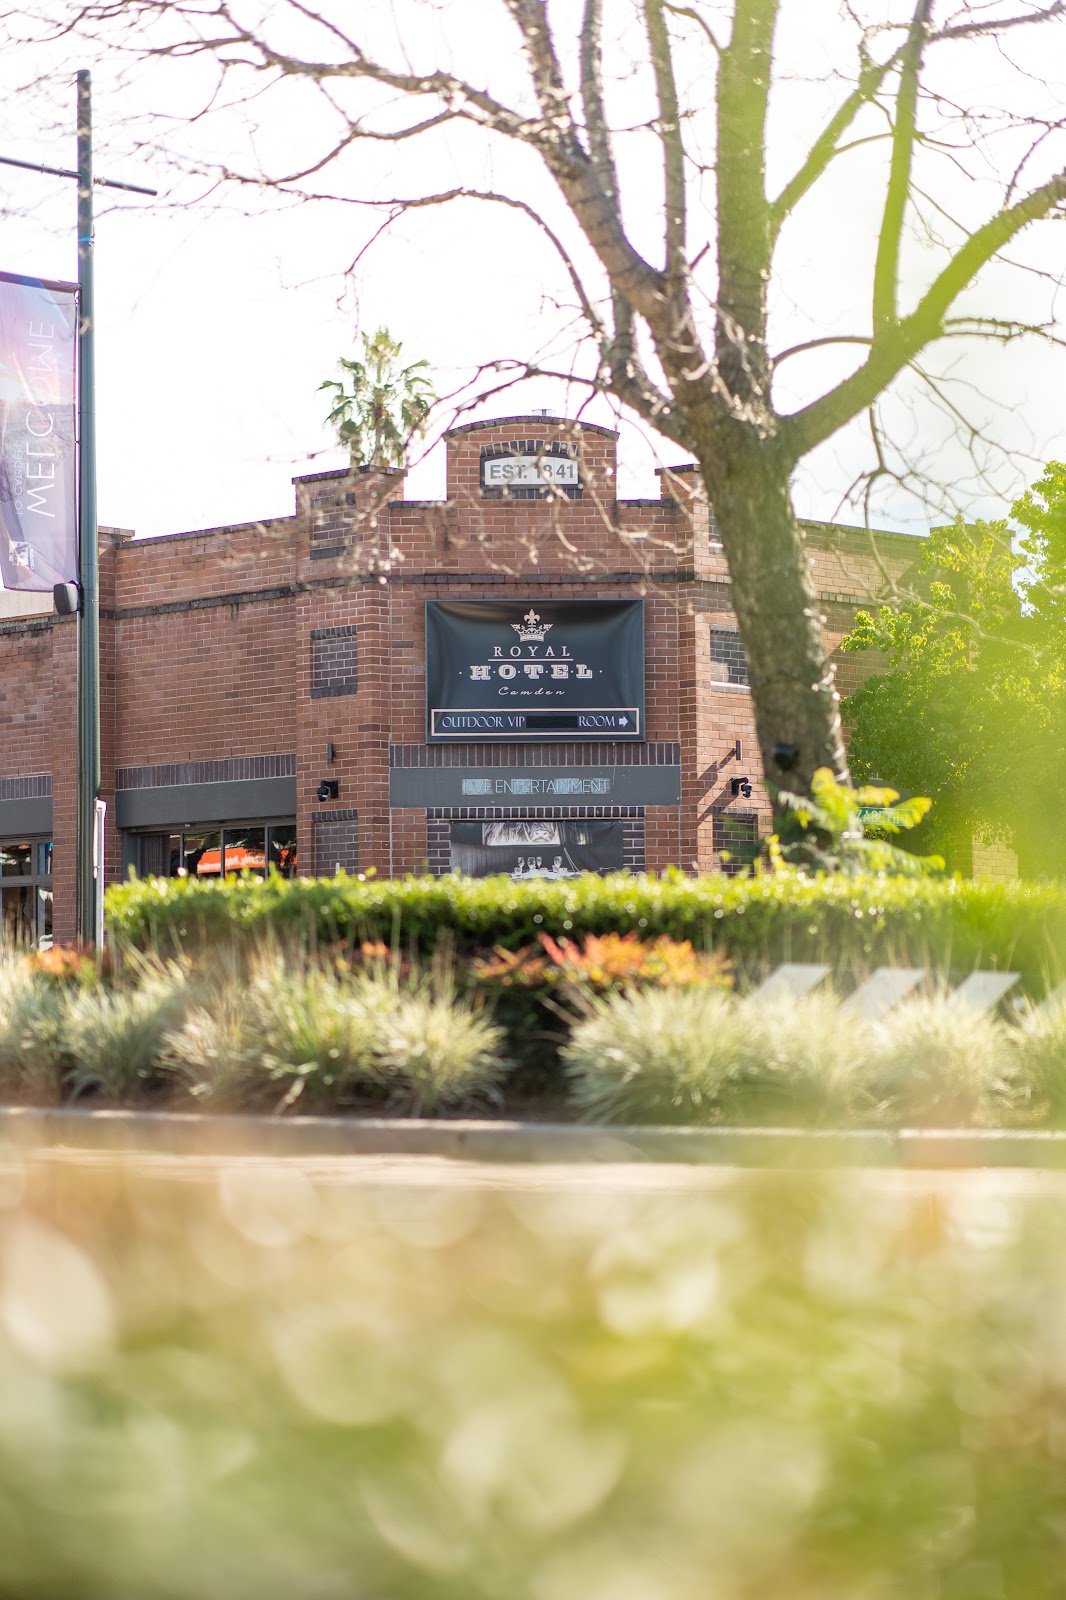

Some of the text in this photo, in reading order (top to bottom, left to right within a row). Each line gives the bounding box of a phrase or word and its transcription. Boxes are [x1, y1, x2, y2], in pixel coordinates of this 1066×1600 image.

[489, 464, 528, 479] EST.
[493, 646, 570, 657] ROYAL
[498, 686, 566, 696] Camden
[442, 715, 616, 728] OUTDOOR VIP ROOM
[463, 779, 609, 794] LVE ENTERTAINMENT
[856, 809, 899, 824] ZABETH
